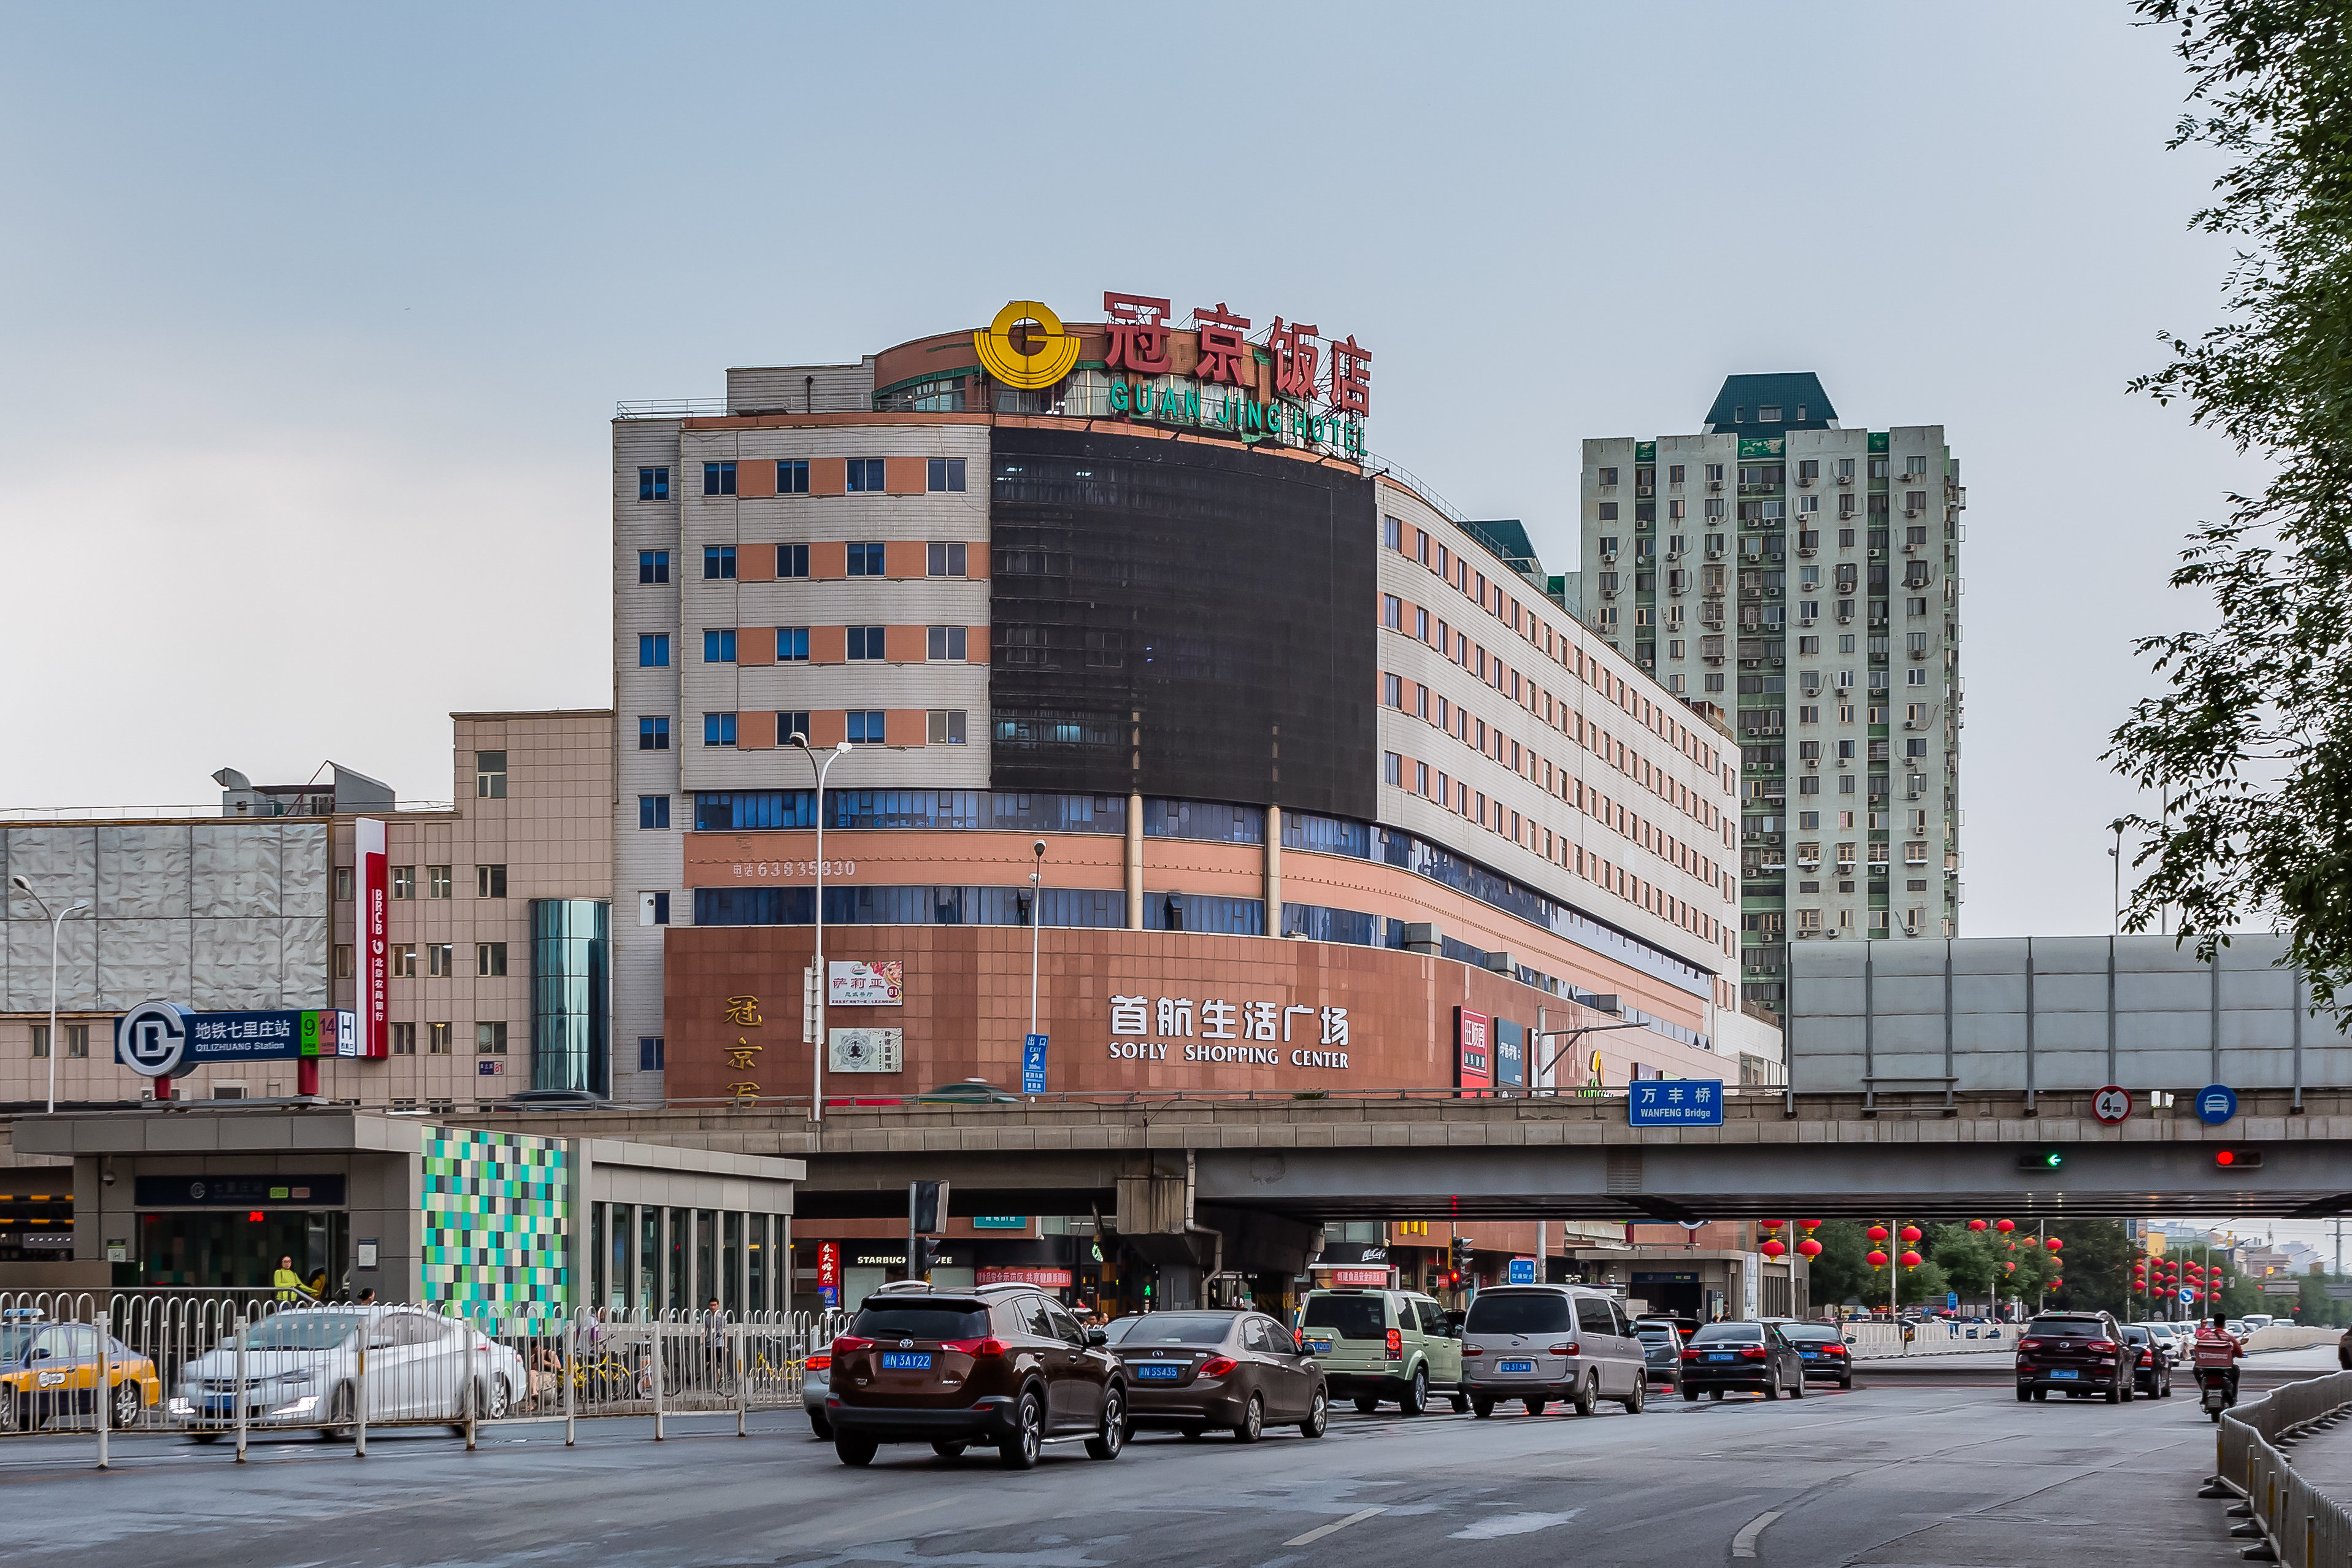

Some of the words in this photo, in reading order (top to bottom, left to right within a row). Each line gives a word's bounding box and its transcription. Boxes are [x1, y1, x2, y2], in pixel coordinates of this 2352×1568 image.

[1104, 290, 1372, 418] 冠京饭店
[1110, 381, 1201, 420] GUAN
[1215, 395, 1281, 433] JING
[1293, 416, 1369, 457] HOTEL
[758, 861, 856, 877] 63835830
[833, 977, 885, 990] 萨莉亚
[195, 1019, 291, 1040] 地铁七里庄站
[304, 1018, 315, 1037] 9
[319, 1017, 336, 1036] 14
[341, 1015, 352, 1040] H
[1110, 994, 1349, 1046] 首航生活广场
[195, 1042, 252, 1053] QILIZHUANG
[253, 1042, 285, 1050] Station
[1028, 1036, 1047, 1047] 出口
[1109, 1042, 1168, 1059] SOFLY
[1185, 1045, 1279, 1065] SHOPPING
[1291, 1049, 1349, 1069] CENTER
[1641, 1087, 1711, 1104] 万丰桥
[1640, 1108, 1681, 1118] WANFENG
[1685, 1107, 1710, 1119] Bridge
